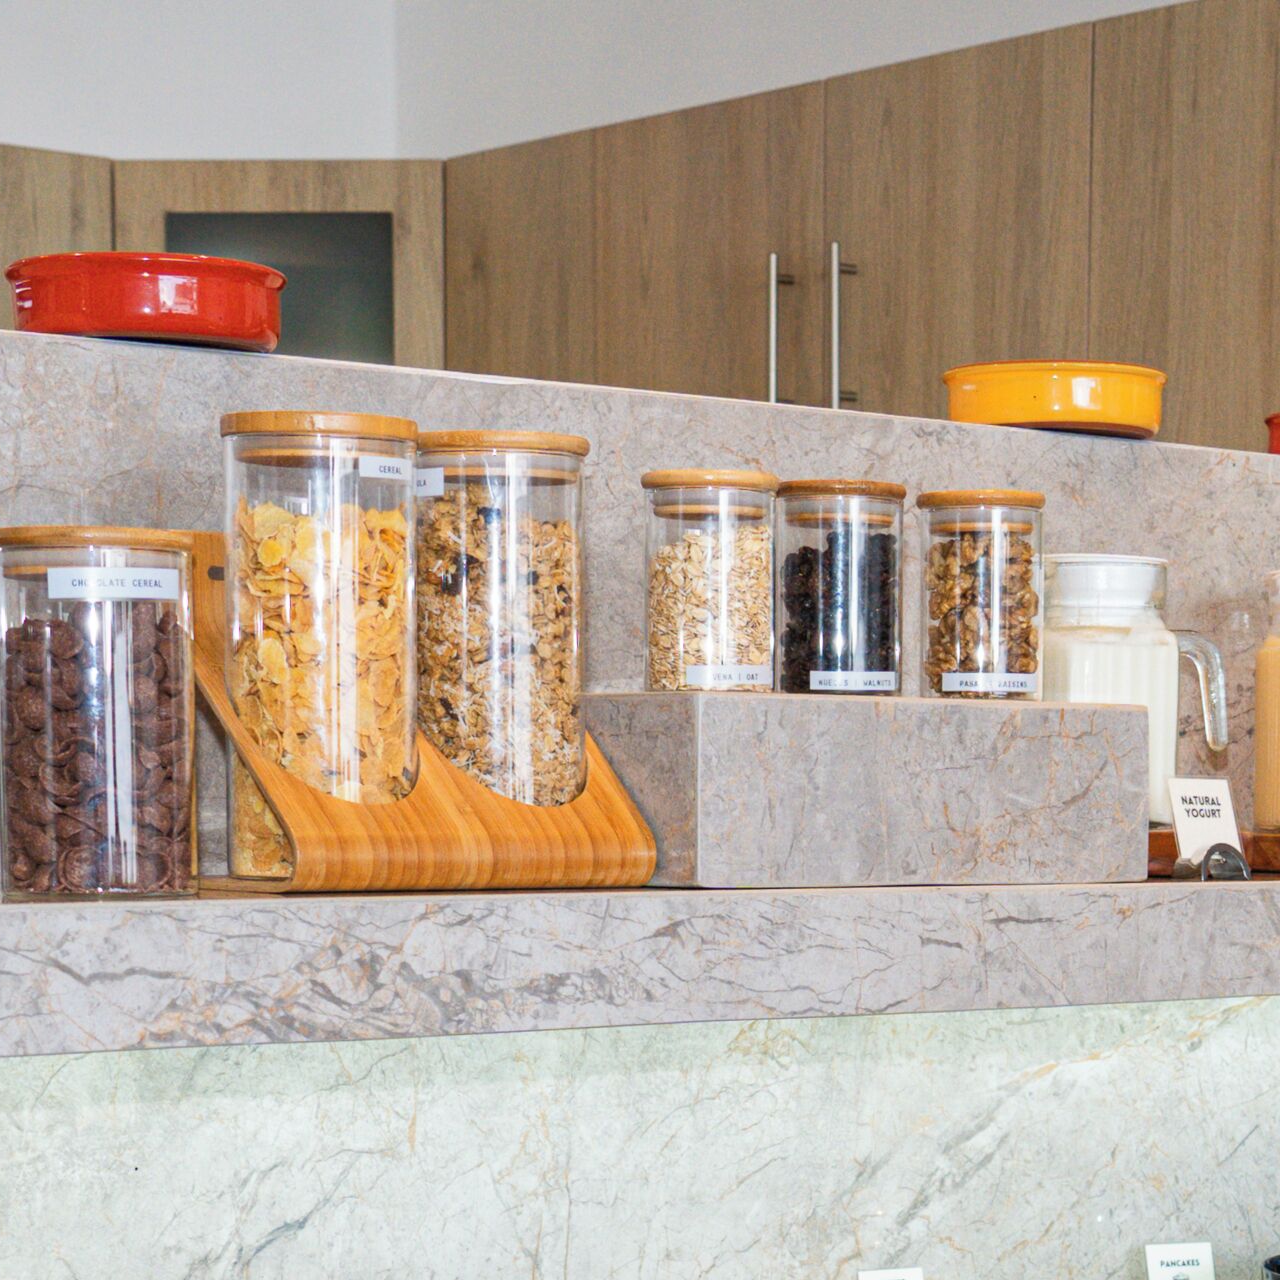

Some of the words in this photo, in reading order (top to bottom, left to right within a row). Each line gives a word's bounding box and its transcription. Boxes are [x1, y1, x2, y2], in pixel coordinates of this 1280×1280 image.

[378, 465, 403, 475] CEREAL
[71, 578, 126, 588] CHLATE
[132, 578, 162, 588] CEREAL
[818, 679, 849, 687] NUES
[1181, 796, 1221, 806] NATURAL
[1184, 808, 1221, 818] YOGURT
[1160, 1259, 1200, 1268] PANCAKES
